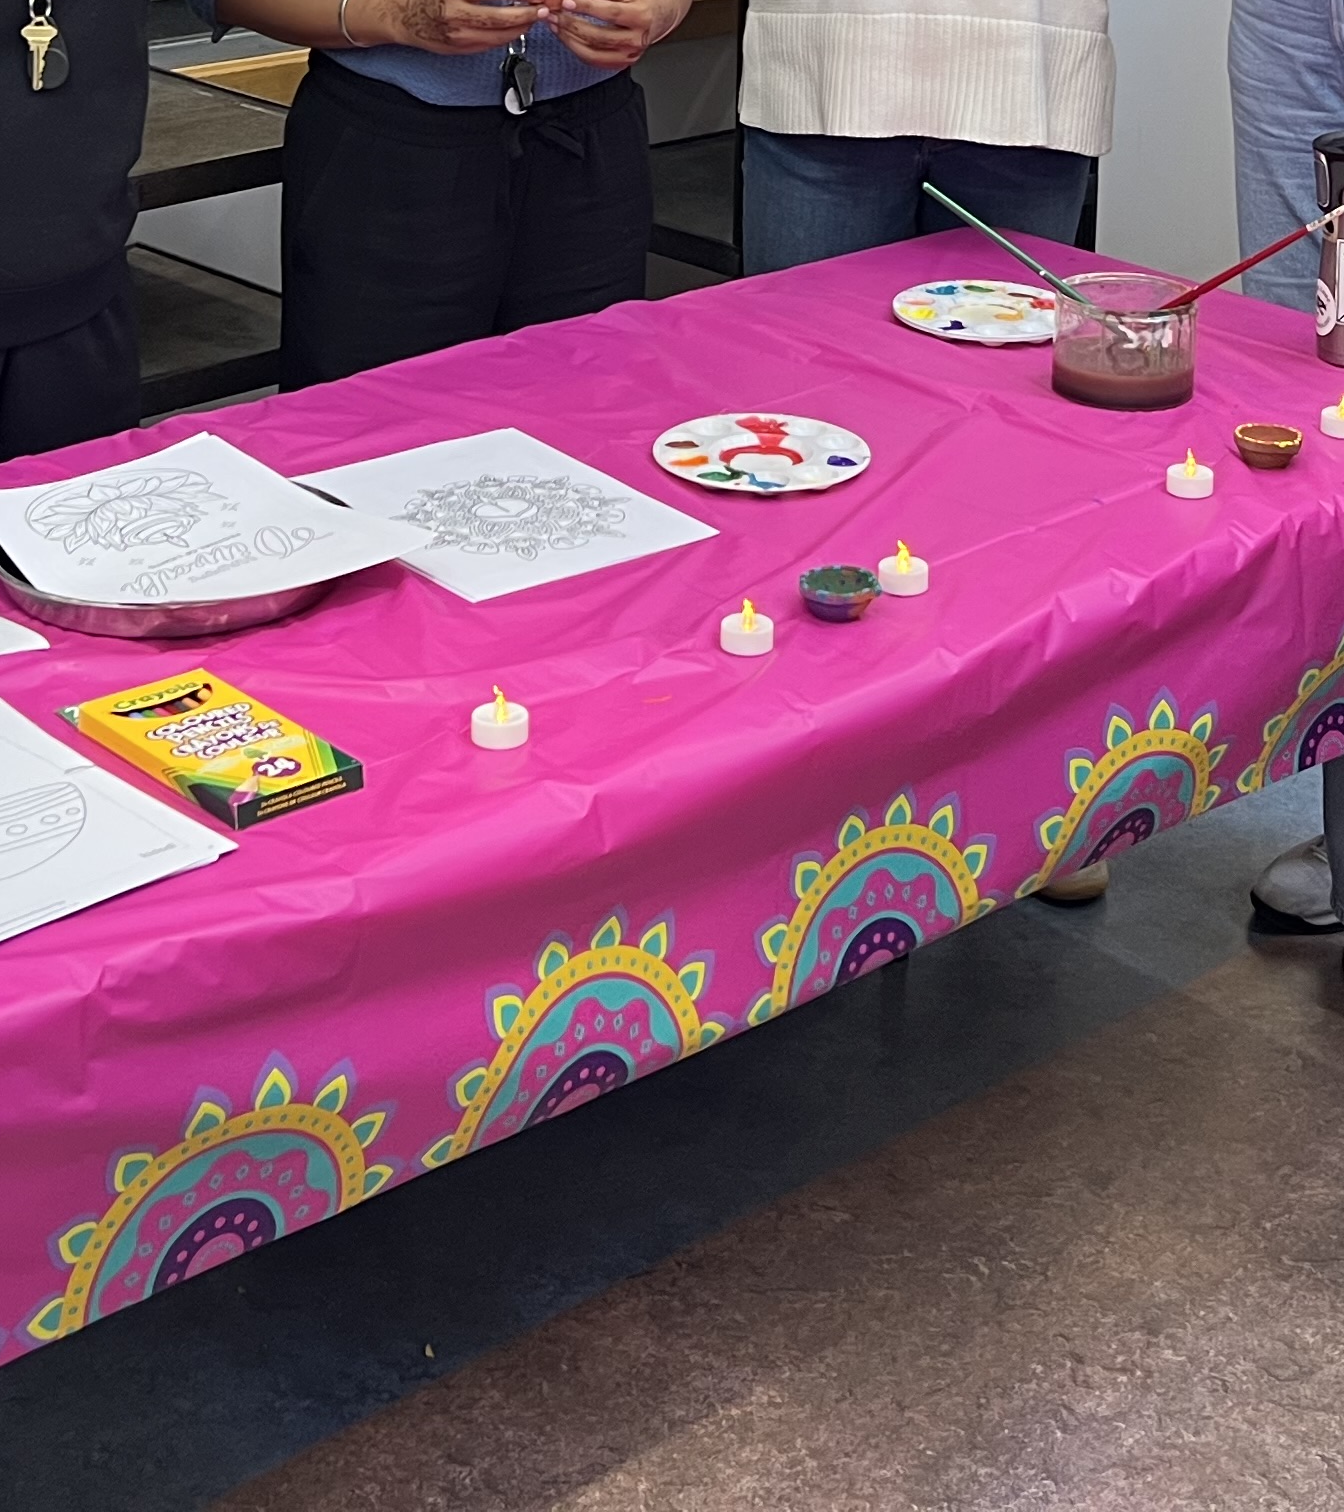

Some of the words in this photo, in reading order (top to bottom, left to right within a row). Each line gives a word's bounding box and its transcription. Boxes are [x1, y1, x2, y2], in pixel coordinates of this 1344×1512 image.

[113, 680, 199, 711] Crayola
[146, 702, 252, 740] COLOURED
[166, 713, 254, 744] PENCILS
[257, 757, 296, 777] 24
